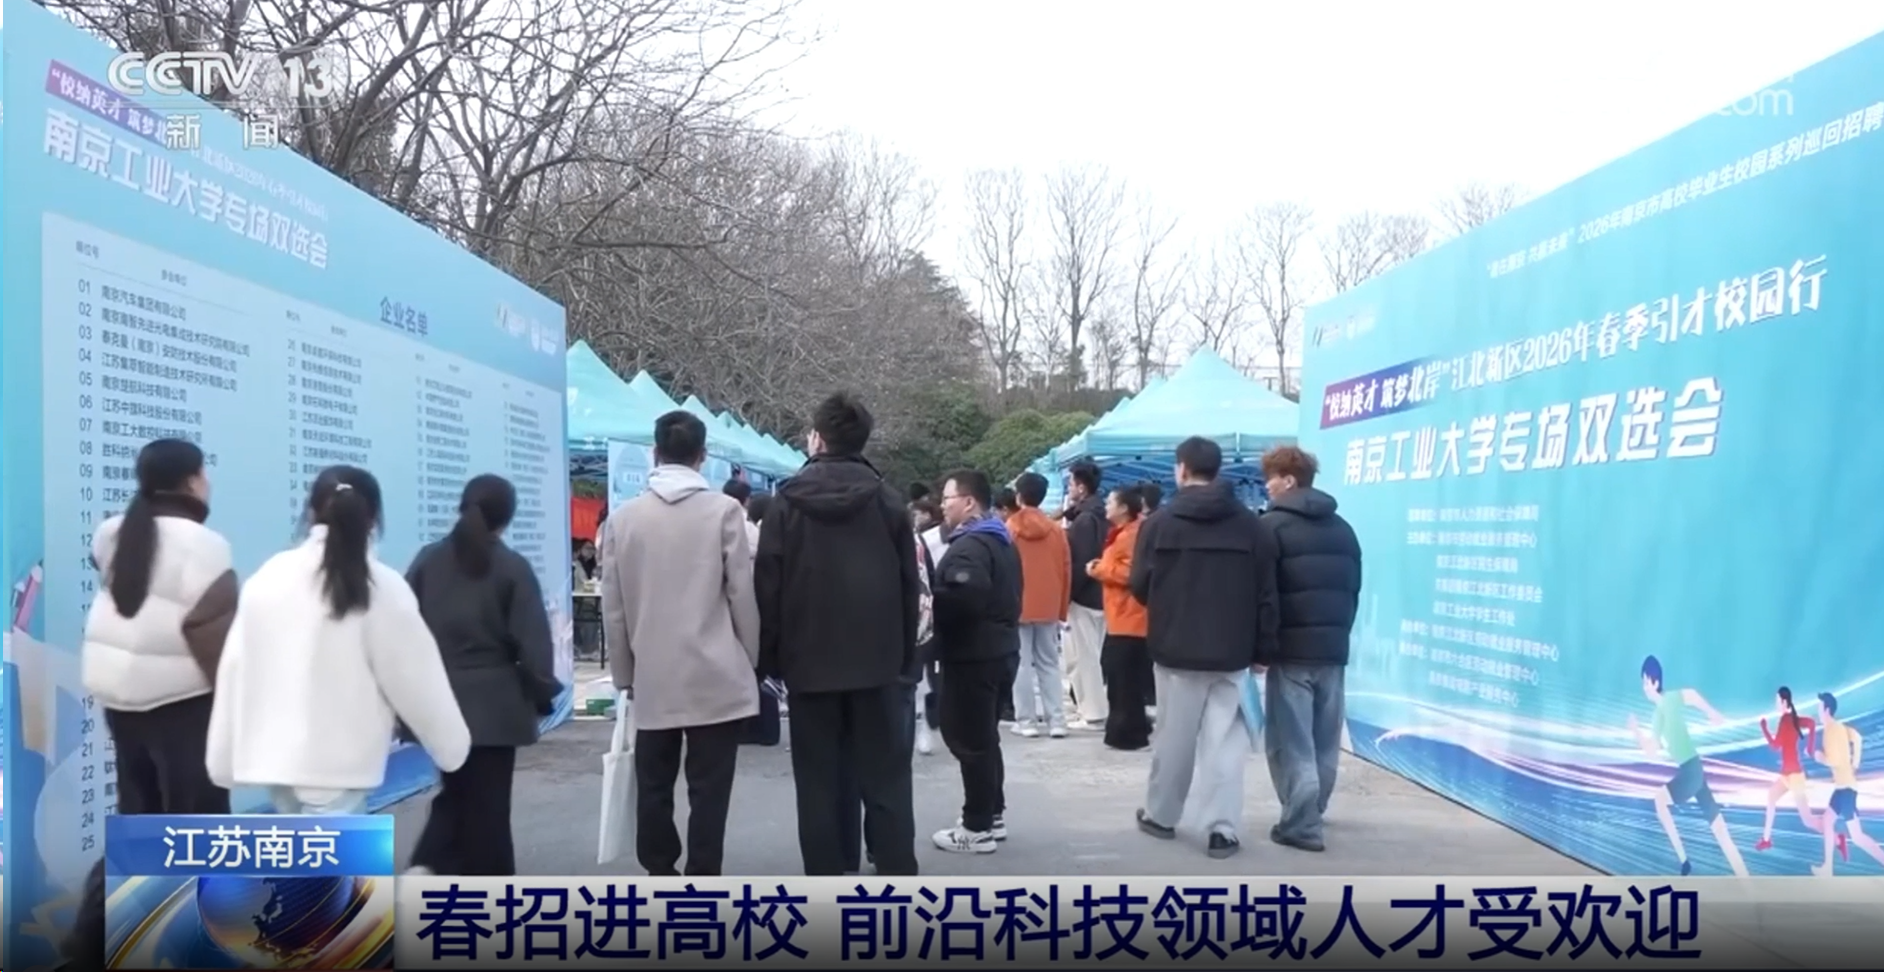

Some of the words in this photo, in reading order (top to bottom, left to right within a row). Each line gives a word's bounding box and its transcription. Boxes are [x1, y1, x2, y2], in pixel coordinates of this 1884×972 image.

[44, 107, 328, 269] 南京工业大学专场双选会
[78, 278, 91, 295] 01
[78, 302, 92, 318] 02
[379, 295, 429, 338] 企业名单
[78, 325, 92, 341] 03
[78, 348, 92, 363] 04
[79, 371, 93, 387] 05
[79, 394, 93, 410] 06
[79, 418, 93, 433] 07
[1343, 377, 1725, 486] 南京工业大学专场双选会
[79, 441, 93, 456] 08
[79, 464, 93, 479] 09
[80, 487, 93, 502] 10
[80, 510, 92, 525] 11
[81, 534, 93, 548] 12
[81, 580, 93, 593] 14
[82, 695, 94, 710] 19
[81, 719, 95, 735] 20
[82, 743, 93, 758] 21
[82, 766, 95, 781] 22
[82, 789, 95, 805] 23
[82, 811, 95, 828] 24
[82, 835, 95, 851] 25
